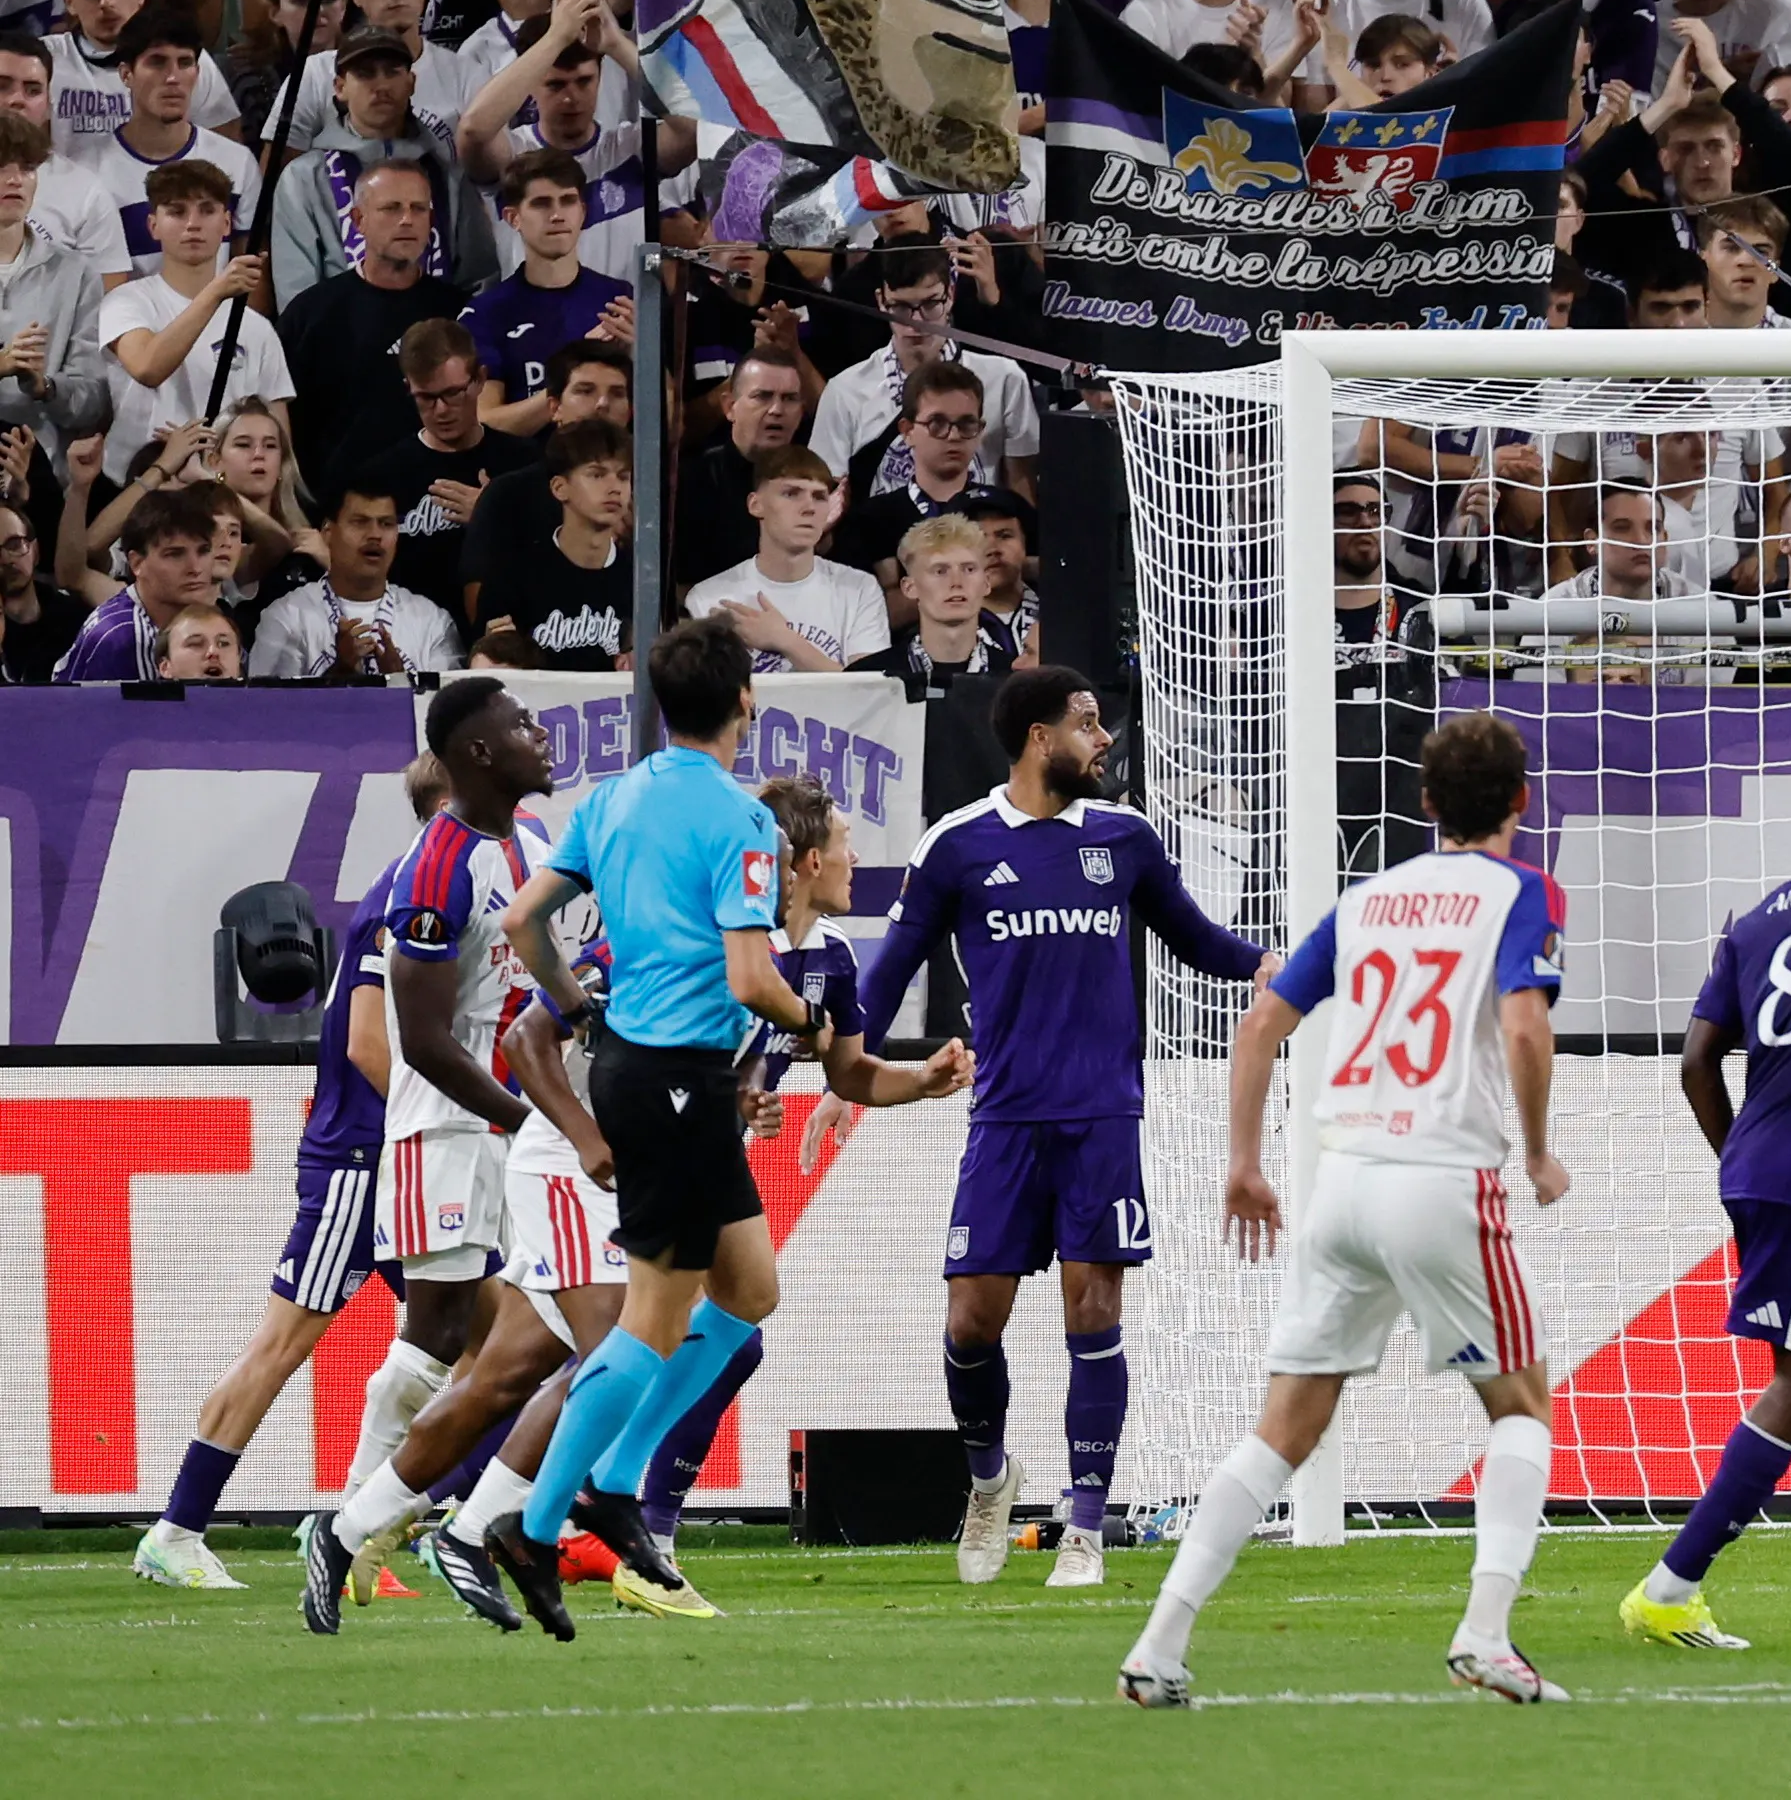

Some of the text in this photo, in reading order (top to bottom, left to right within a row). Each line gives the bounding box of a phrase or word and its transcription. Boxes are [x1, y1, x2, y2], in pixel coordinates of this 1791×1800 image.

[58, 88, 132, 119] ANDERL
[1091, 152, 1146, 205] De
[1149, 166, 1353, 233] Bruxelles
[1400, 181, 1533, 231] Lyon
[1139, 233, 1272, 286] contre
[1271, 239, 1331, 290] la
[1332, 233, 1556, 296] répressio
[1163, 294, 1250, 347] Army
[1258, 310, 1283, 345] &
[533, 603, 622, 650] Anderle
[986, 905, 1122, 942] Sunweb
[1361, 892, 1480, 928] MORTON
[1331, 948, 1463, 1089] 23
[1111, 1197, 1152, 1250] 12
